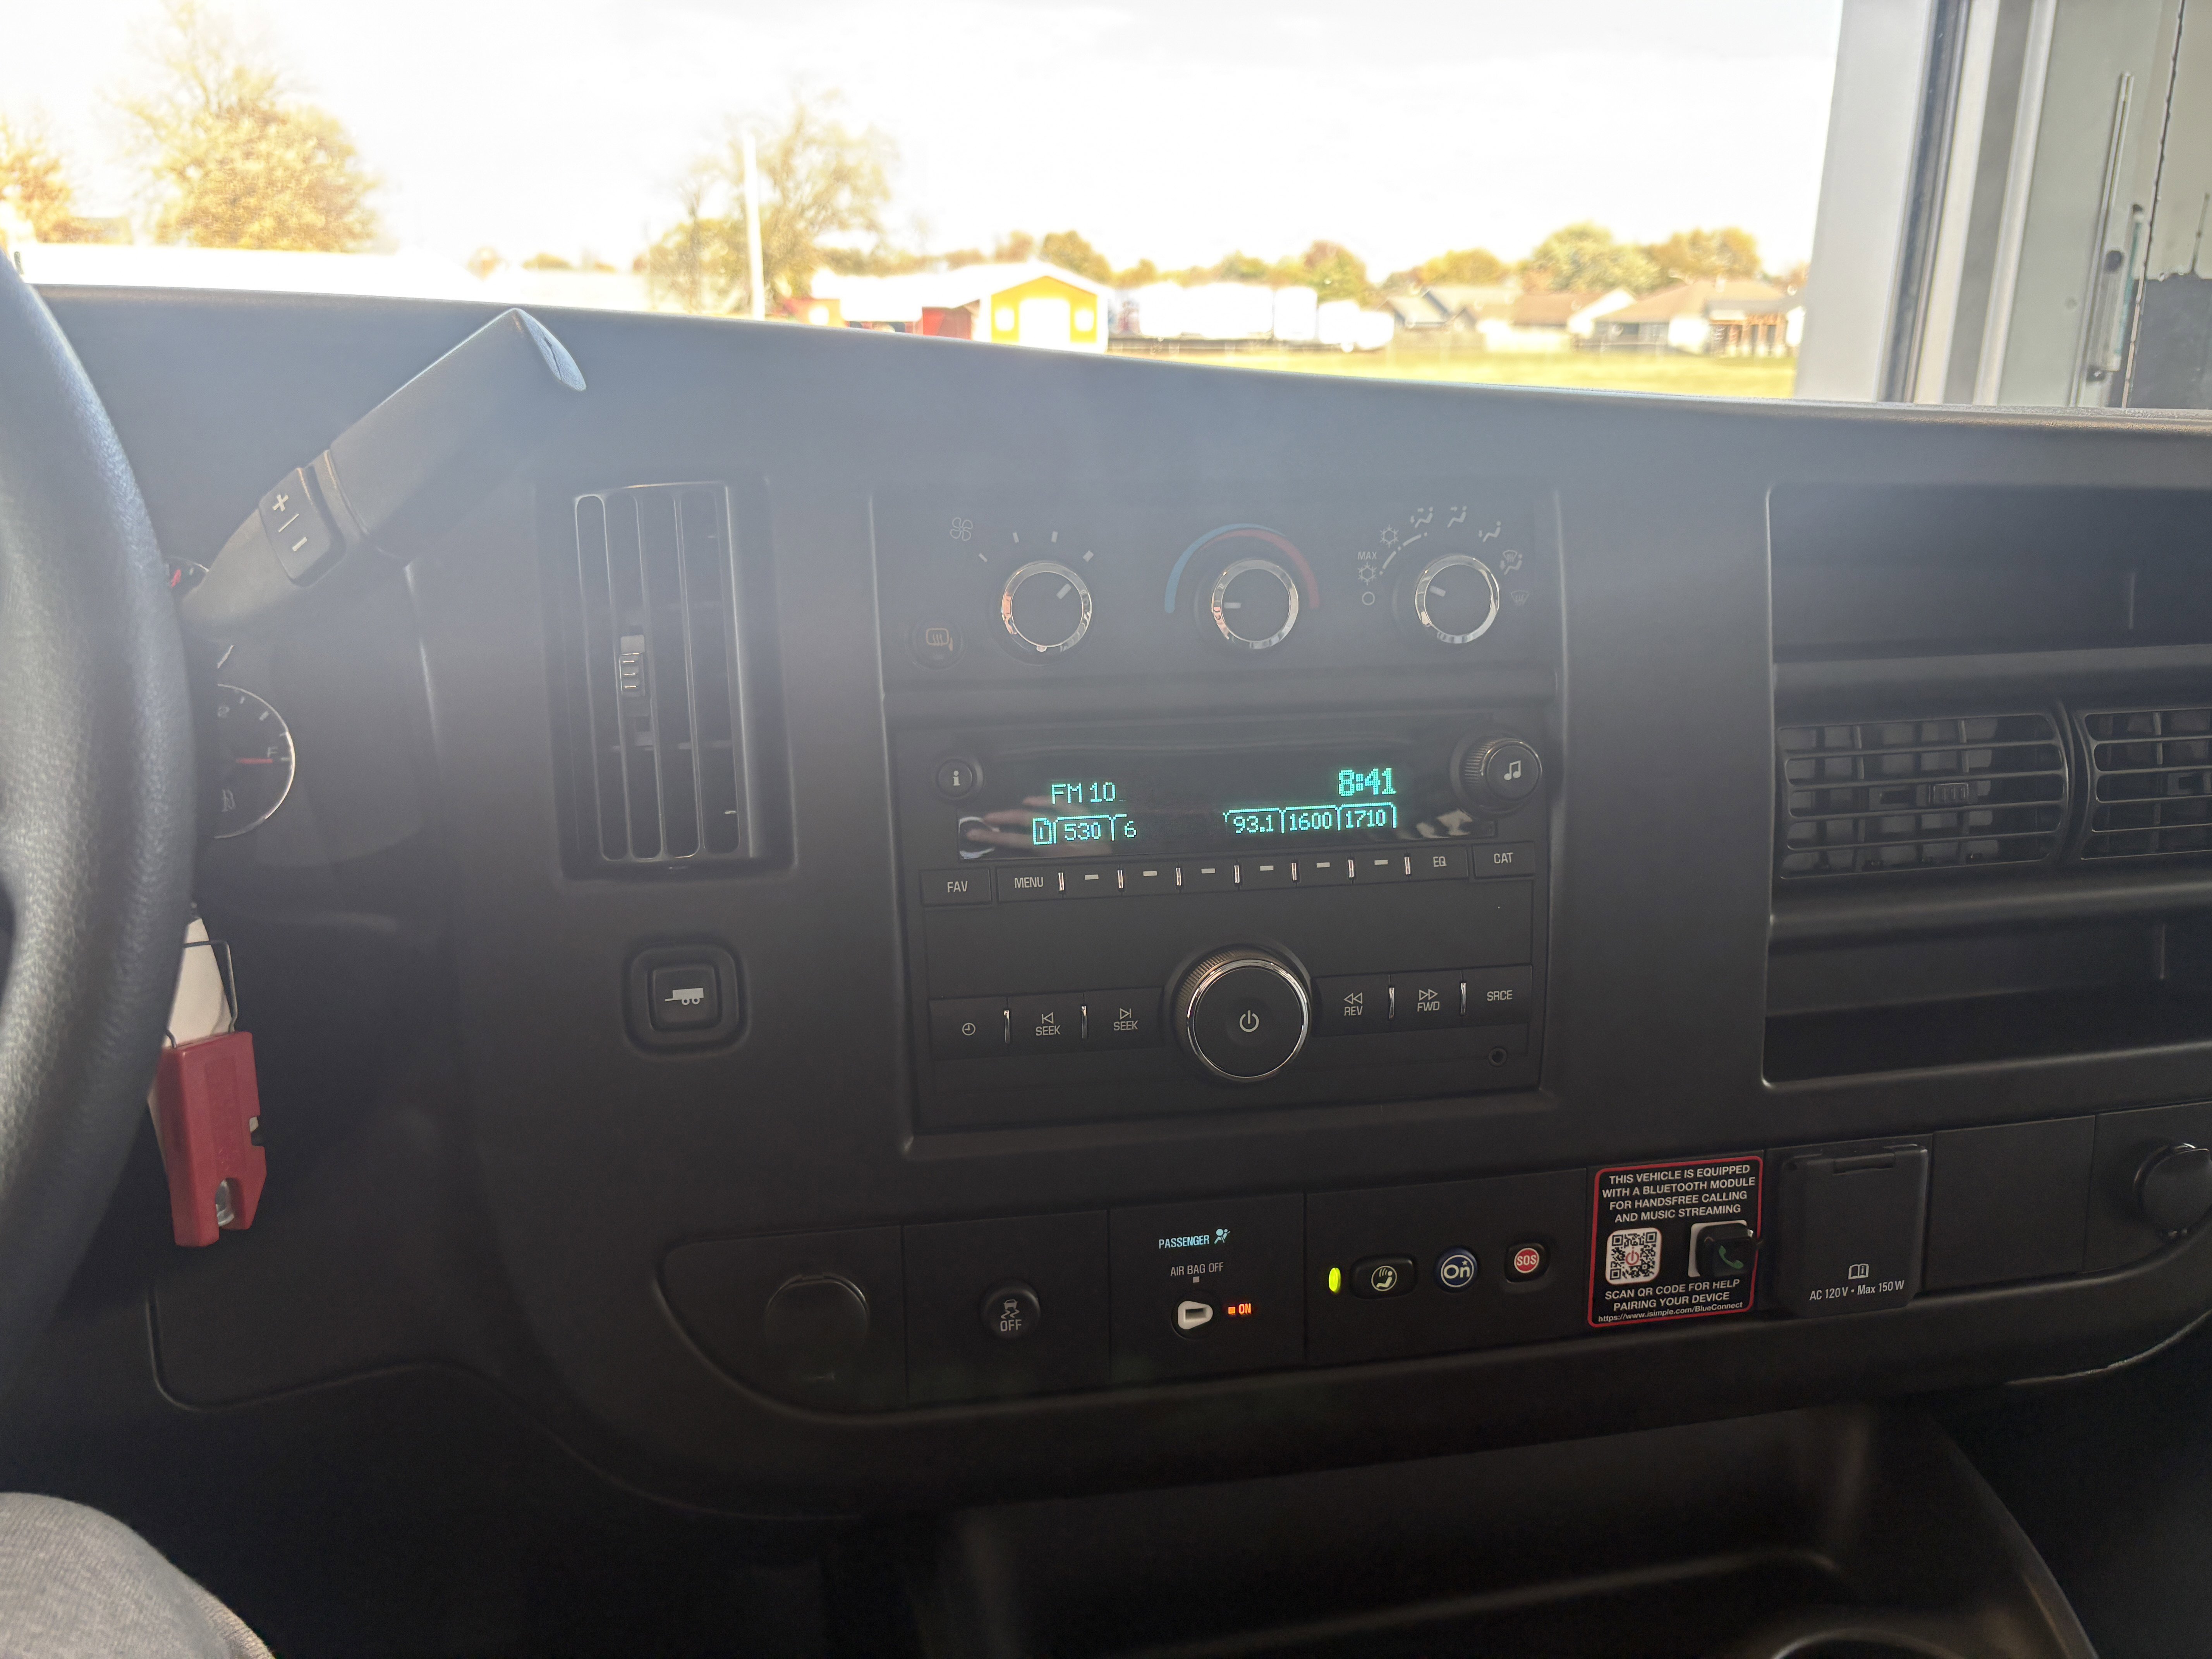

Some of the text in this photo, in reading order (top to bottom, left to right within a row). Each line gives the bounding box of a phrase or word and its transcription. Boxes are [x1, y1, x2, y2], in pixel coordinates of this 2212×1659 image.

[1358, 551, 1377, 560] MAX
[1338, 768, 1396, 797] 8:41
[1051, 782, 1116, 804] FM 10
[1233, 814, 1274, 834] 93.1
[1289, 812, 1332, 831] 1600
[1345, 809, 1386, 829] 1710
[1064, 822, 1101, 841] 530
[1124, 820, 1137, 838] 6
[1433, 856, 1447, 867] EQ
[1494, 852, 1513, 864] CAT
[947, 881, 968, 893] FAV
[1014, 877, 1044, 889] MENU
[1487, 989, 1513, 1001] SRCE
[1344, 1006, 1363, 1016] REV
[1417, 1001, 1440, 1012] FWD
[1036, 1025, 1061, 1036] SEEK
[1113, 1020, 1138, 1031] SEEK
[1609, 1164, 1750, 1184] THIS VEHICLE IS EQUIPPED
[1602, 1176, 1756, 1198] WITH A BLUETOOTH MODULE
[1609, 1190, 1747, 1211] FOR HANDSFREE CALLING
[1614, 1204, 1741, 1223] AND MUSIC STREAMING
[1159, 1235, 1210, 1249] PASSENGER
[1516, 1254, 1537, 1266] SOS
[1170, 1262, 1224, 1276] AIR BAG OFF
[1443, 1264, 1470, 1279] On
[1605, 1279, 1740, 1300] SCAN QR CODE FOR HELP
[1809, 1290, 1822, 1300] AC
[1857, 1284, 1875, 1295] Max
[1238, 1303, 1252, 1314] ON
[1613, 1291, 1730, 1311] PAIRING YOUR DEVICE
[1598, 1302, 1743, 1323] https://www.isimple.com/BlueConnect
[1000, 1319, 1022, 1332] OFF
